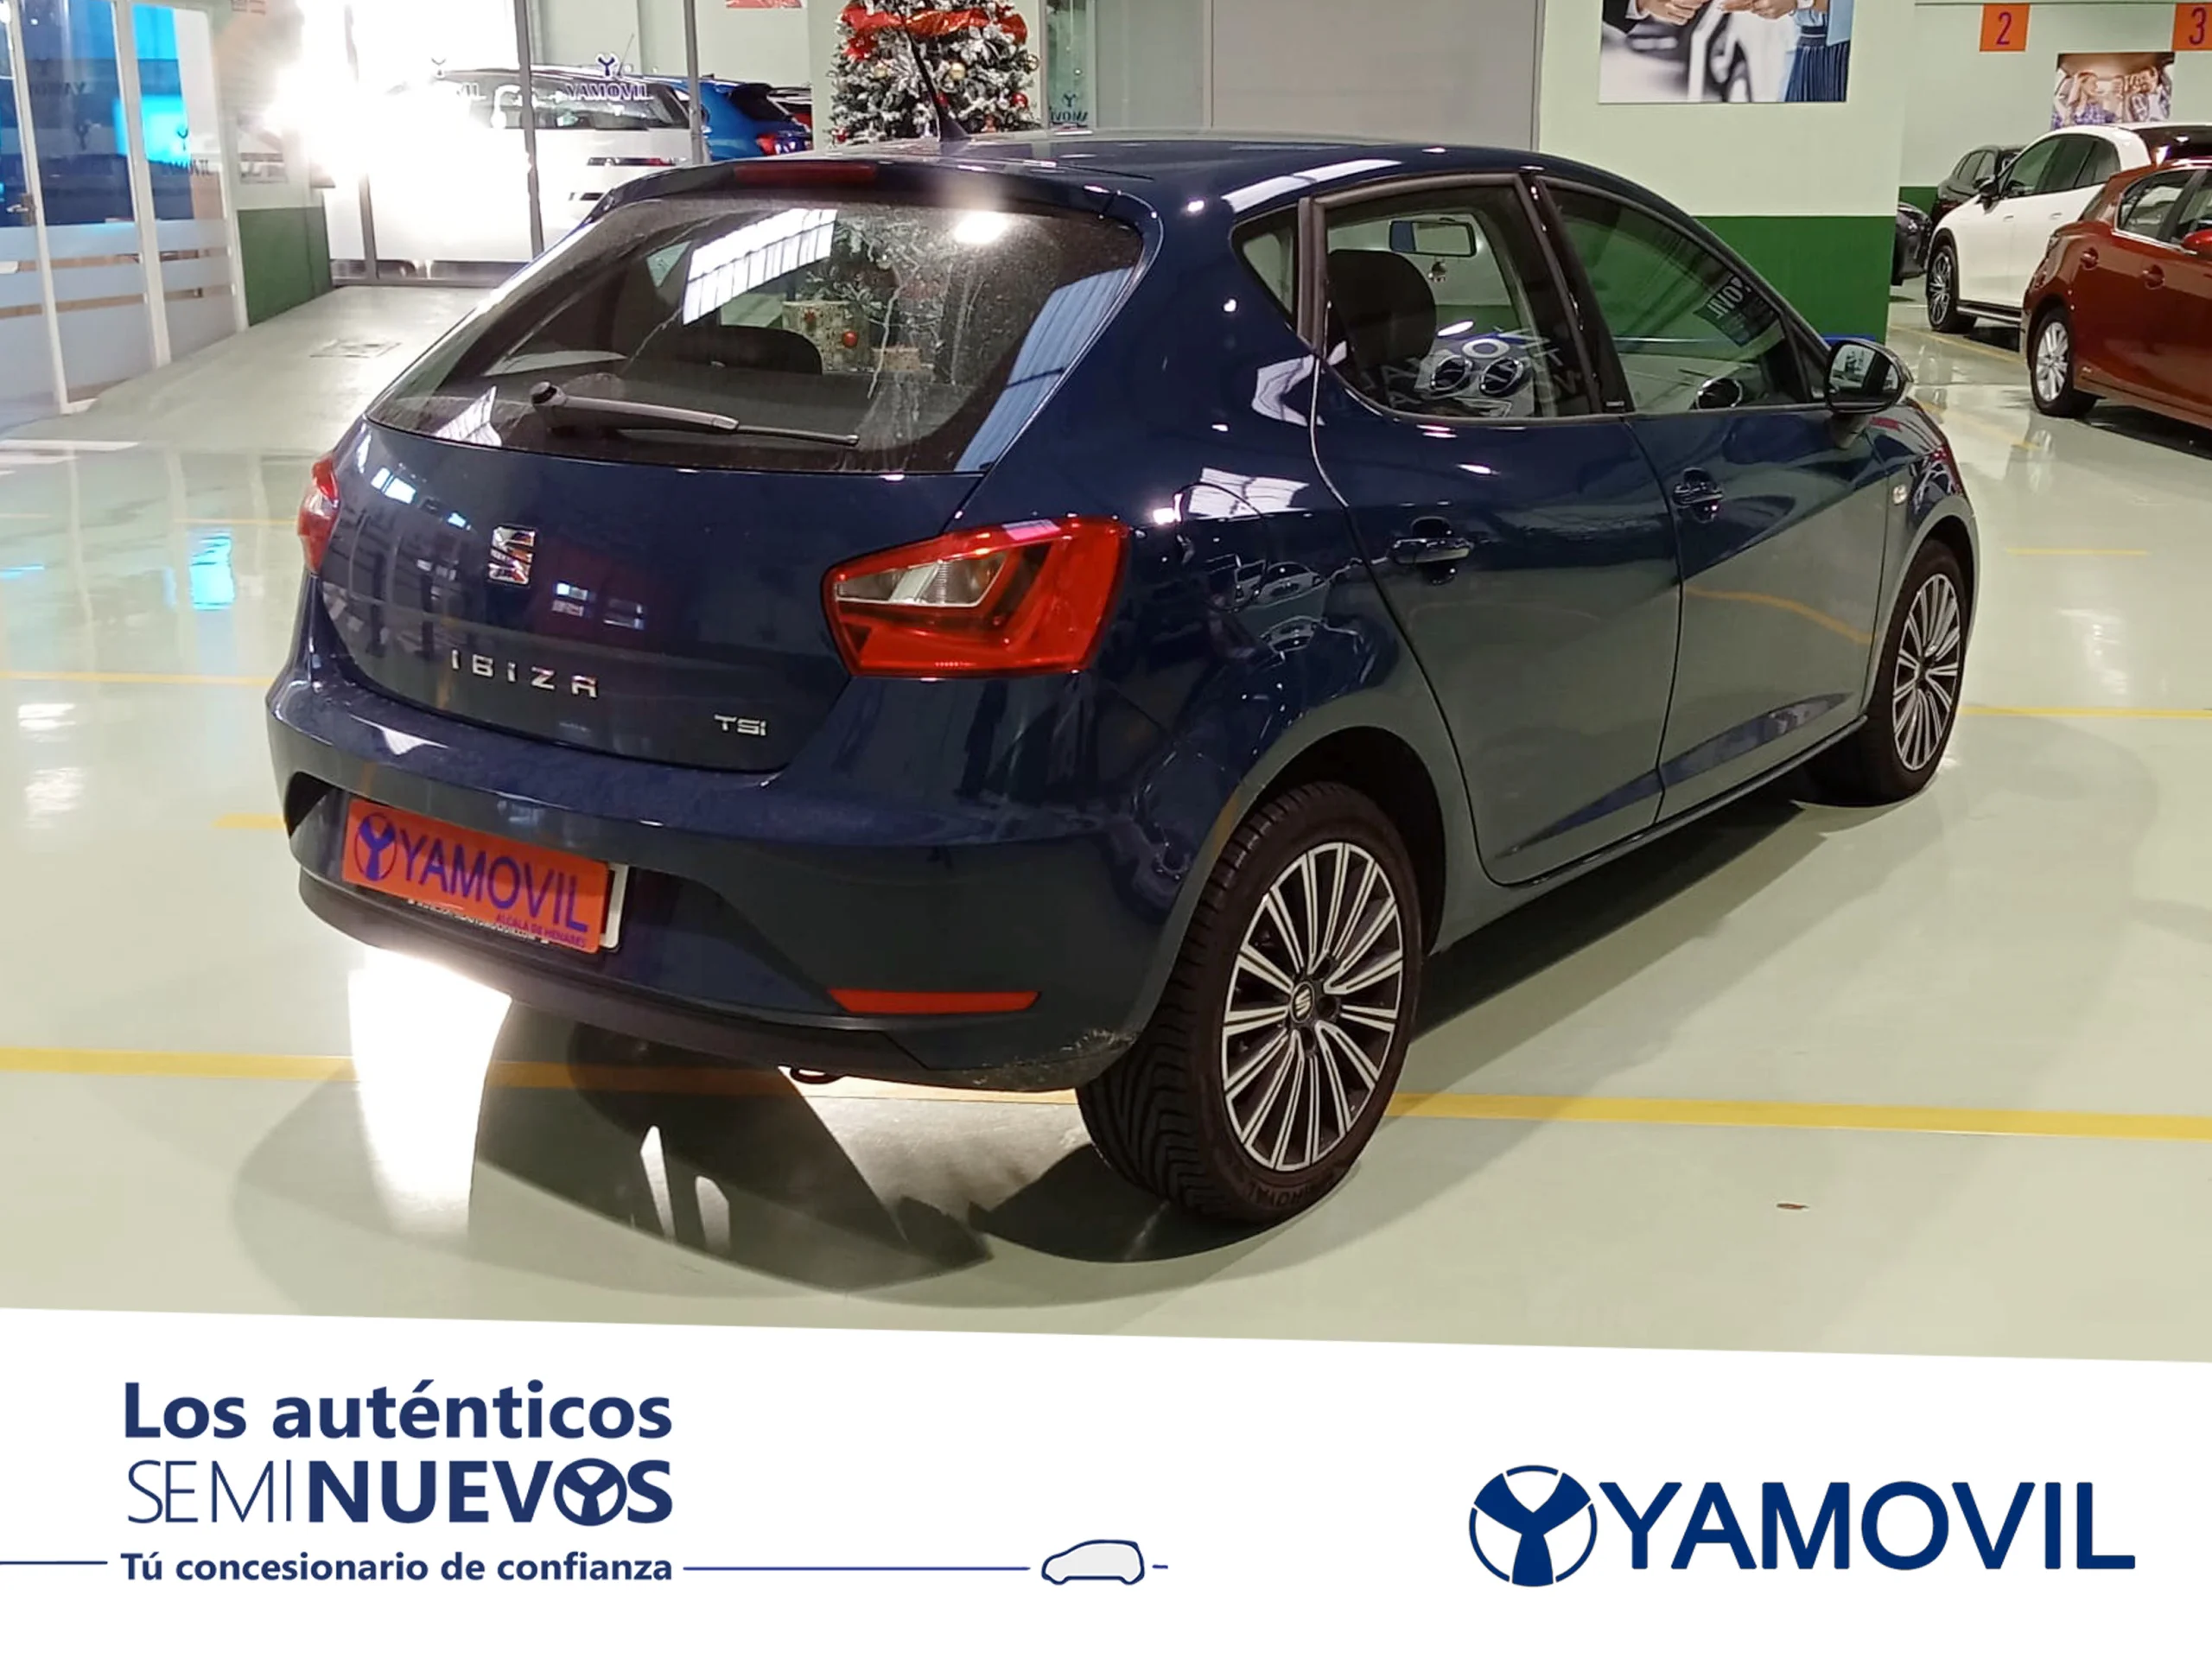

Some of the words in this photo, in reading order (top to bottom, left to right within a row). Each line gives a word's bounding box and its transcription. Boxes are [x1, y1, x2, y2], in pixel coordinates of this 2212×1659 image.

[1995, 11, 2012, 46] 2
[2189, 7, 2207, 46] 3
[451, 649, 598, 698] IBIZA
[400, 828, 588, 933] YAMOVIL
